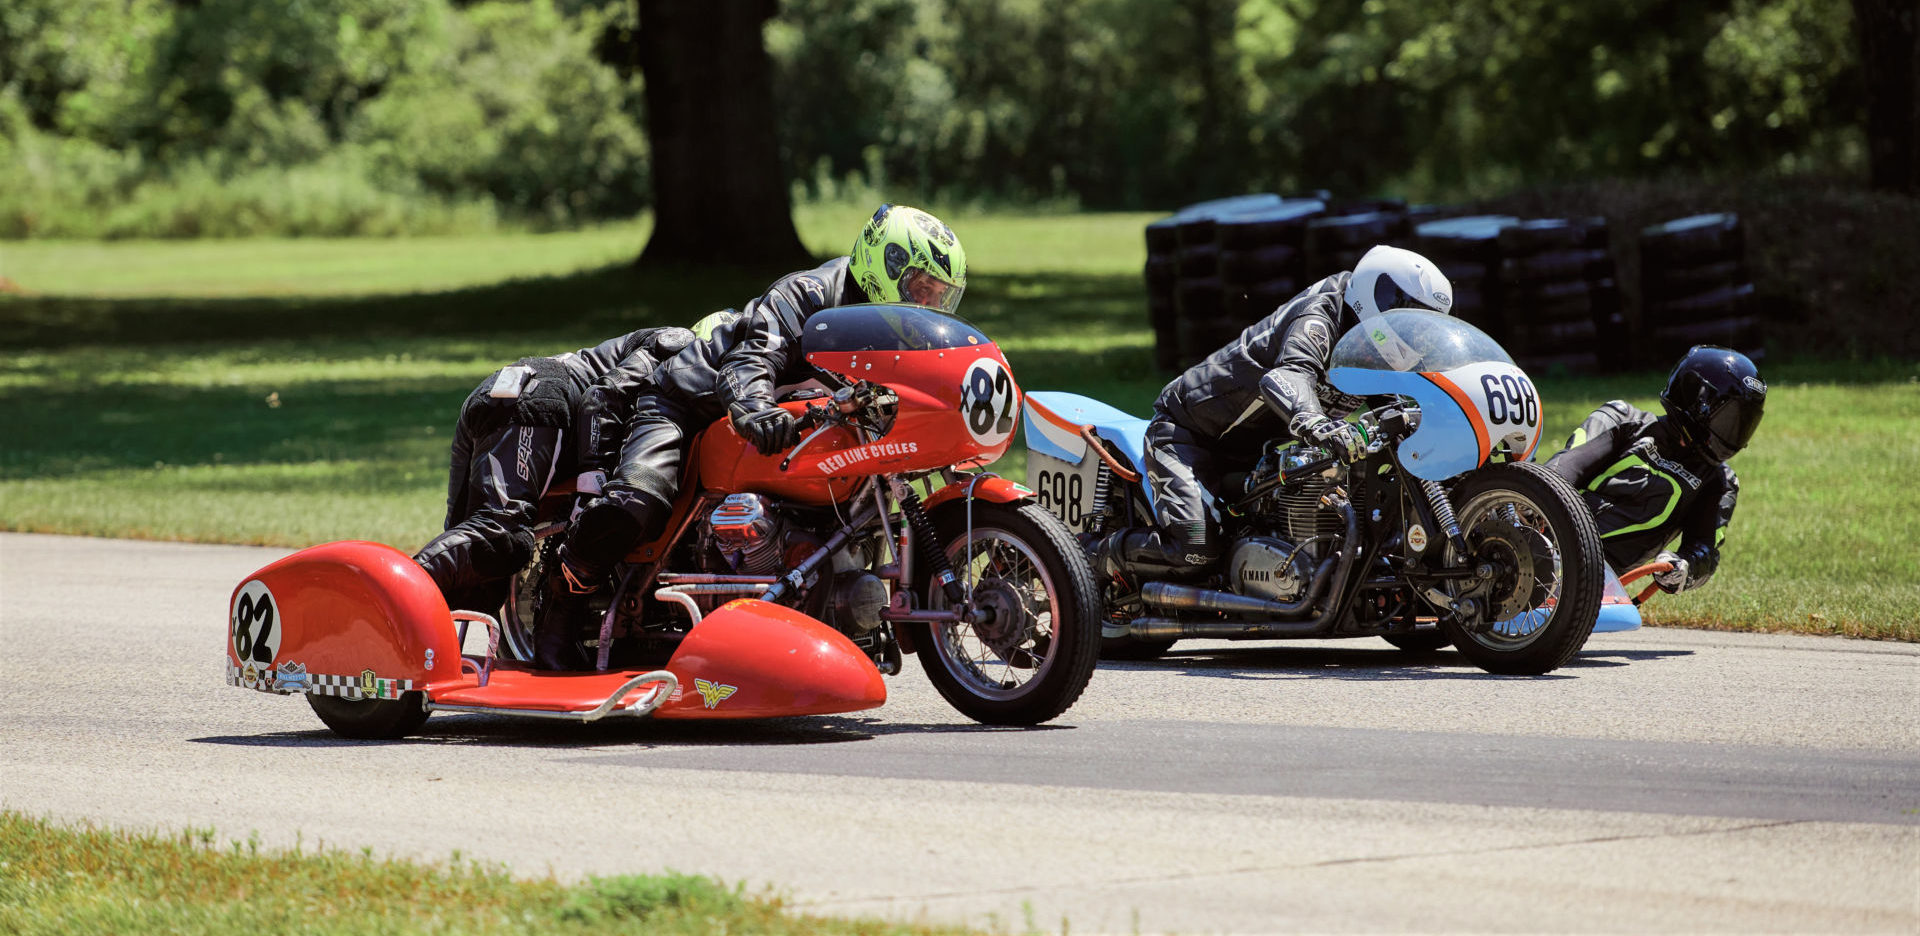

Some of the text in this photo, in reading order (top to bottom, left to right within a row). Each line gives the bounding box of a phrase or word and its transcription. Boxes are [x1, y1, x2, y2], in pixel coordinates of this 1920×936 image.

[1481, 375, 1537, 427] 698
[816, 454, 850, 475] RED
[843, 447, 870, 465] LINE
[869, 442, 918, 458] CYCLES
[1038, 470, 1082, 526] 698
